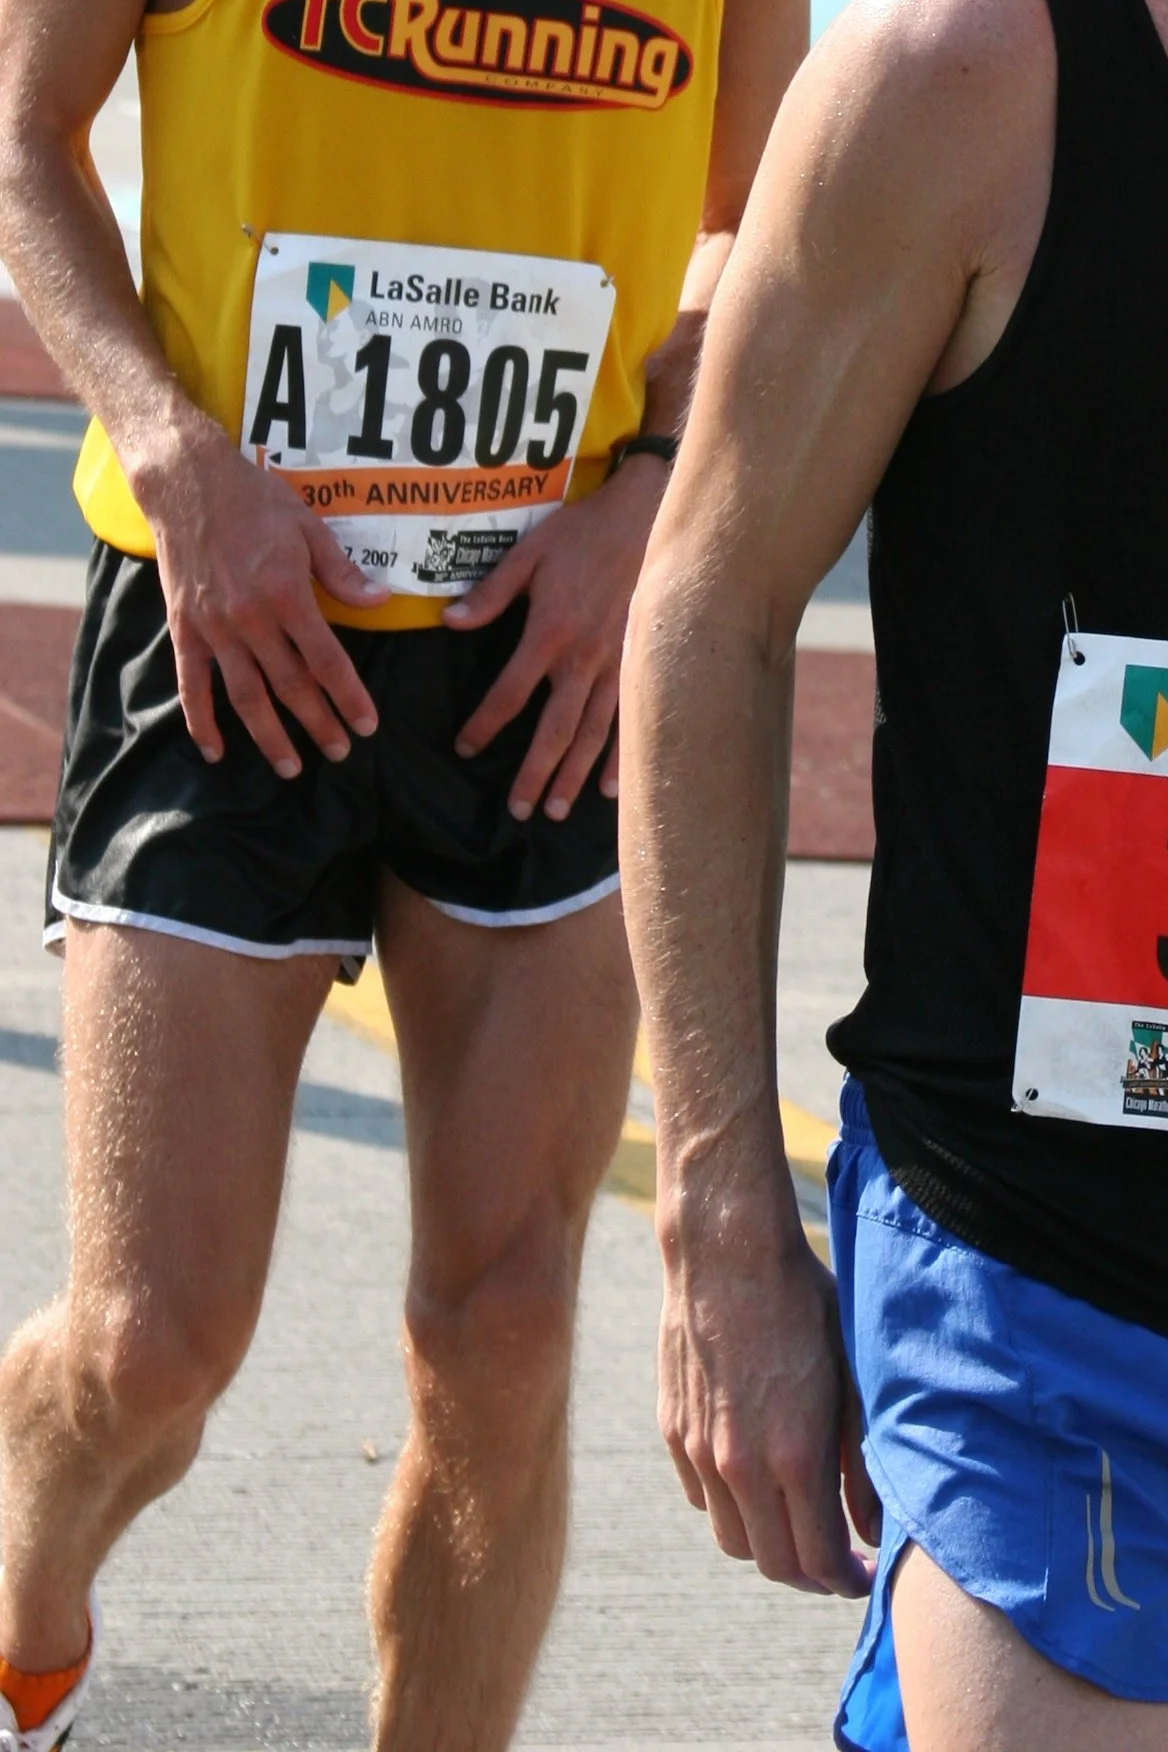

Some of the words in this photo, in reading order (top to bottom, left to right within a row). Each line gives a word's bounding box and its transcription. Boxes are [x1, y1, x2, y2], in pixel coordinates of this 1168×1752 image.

[485, 74, 605, 98] COMPANY
[370, 271, 480, 307] LaSalle
[490, 283, 562, 316] Bank
[365, 310, 404, 329] ABN
[410, 316, 463, 335] AMRO
[249, 324, 306, 450] A
[346, 334, 590, 472] 1805
[302, 480, 355, 507] 30th
[366, 473, 549, 505] ANNIVERSARY
[361, 548, 398, 568] 2007
